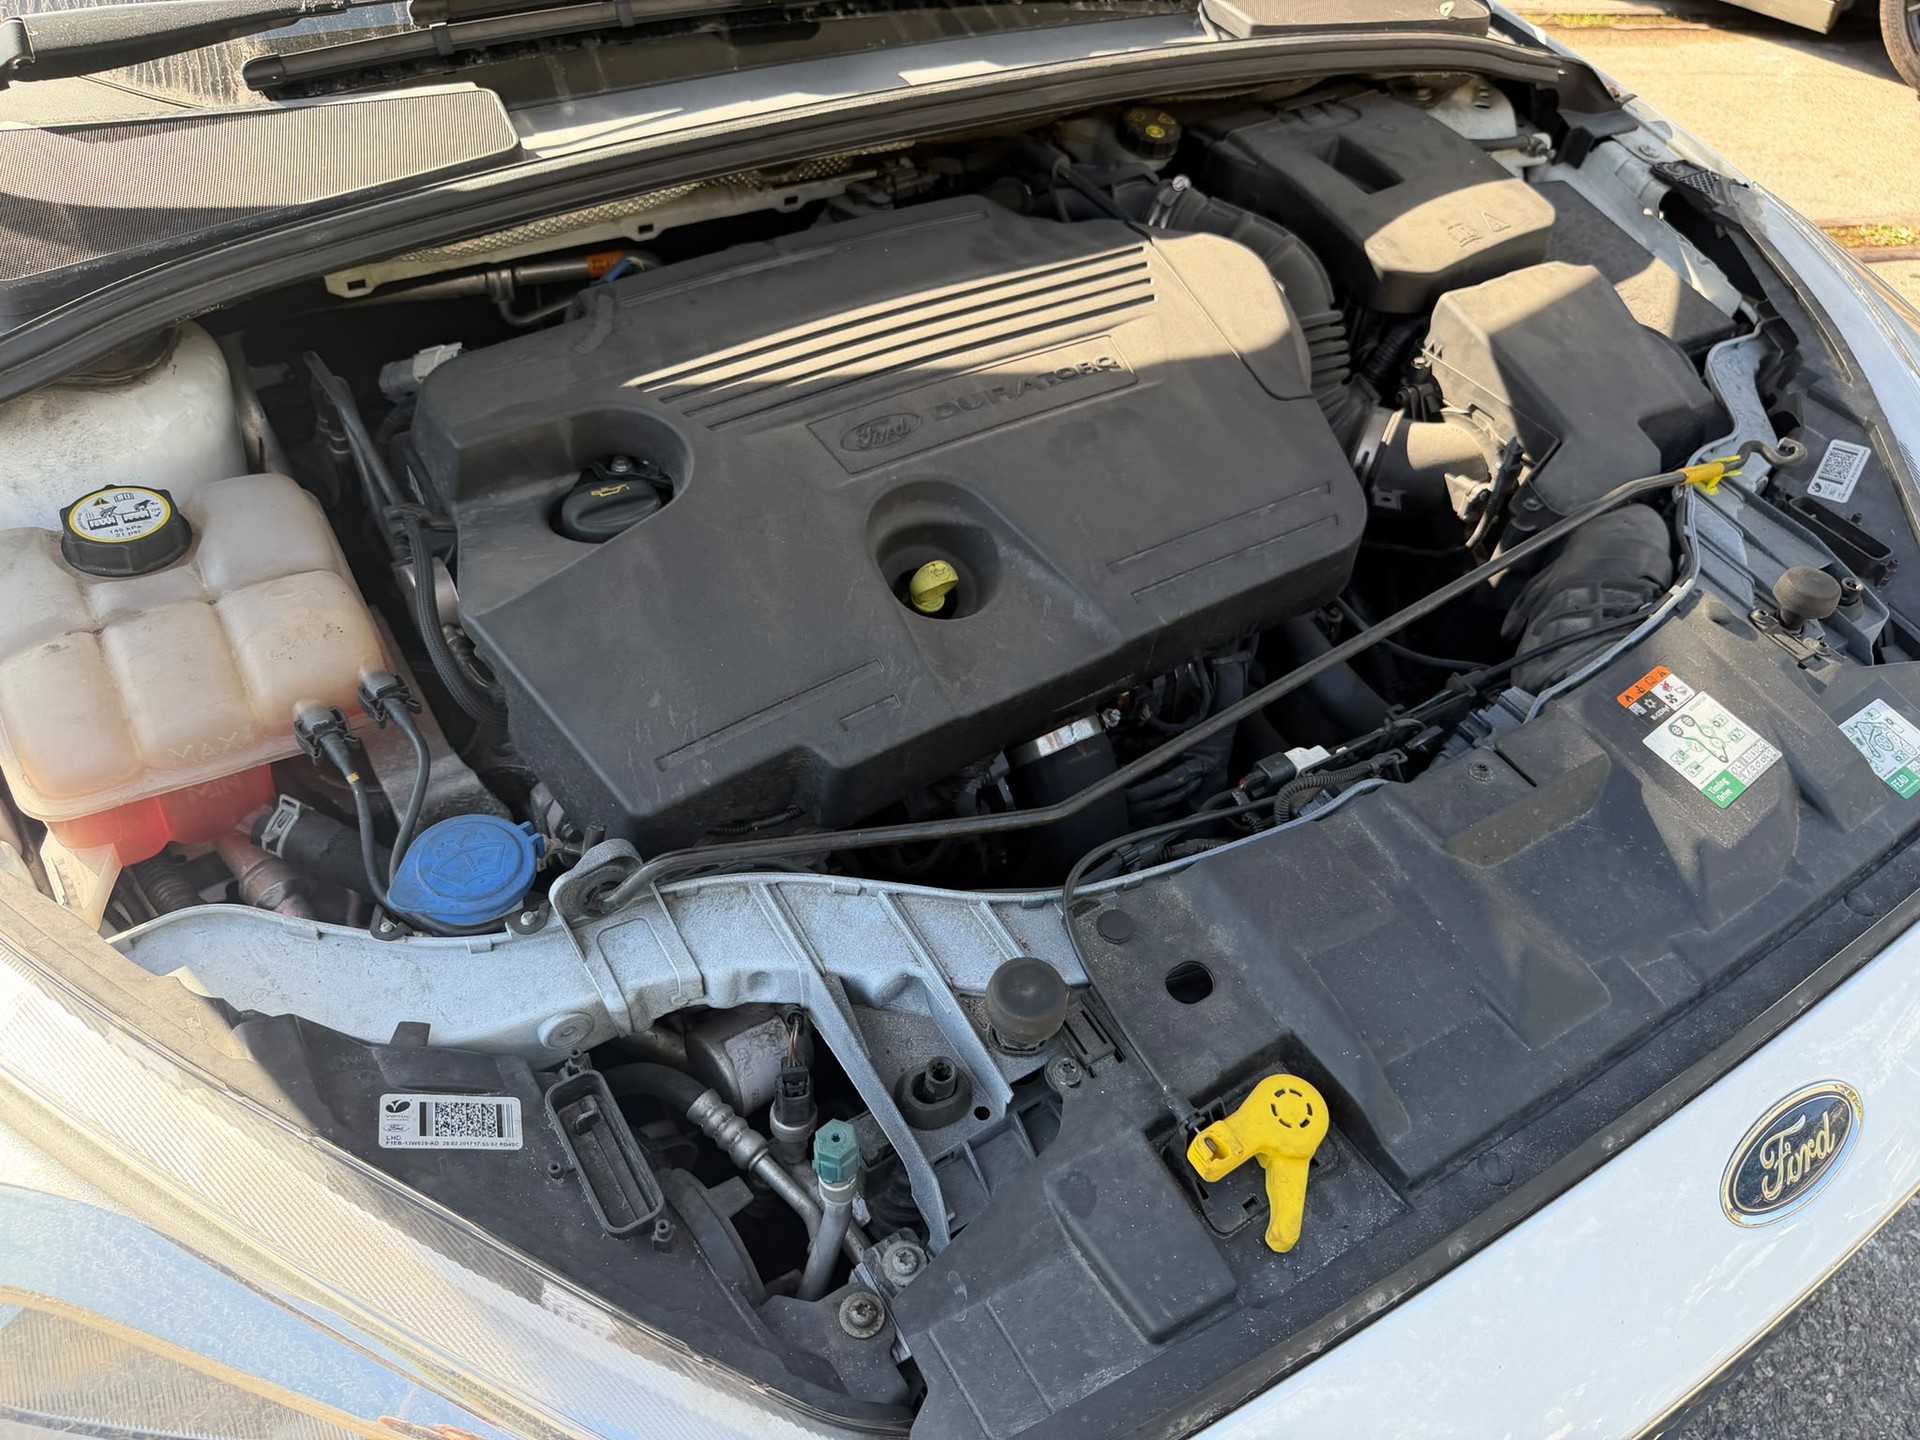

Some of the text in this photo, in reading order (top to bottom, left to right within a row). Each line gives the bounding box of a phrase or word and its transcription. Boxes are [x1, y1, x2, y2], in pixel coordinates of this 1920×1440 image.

[853, 356, 1121, 450] Ford DURATORQ
[167, 731, 242, 766] MAX
[1707, 777, 1730, 795] Timing
[1890, 774, 1910, 790] FEAD
[1716, 789, 1733, 803] Drive
[1759, 1110, 1836, 1201] Ford
